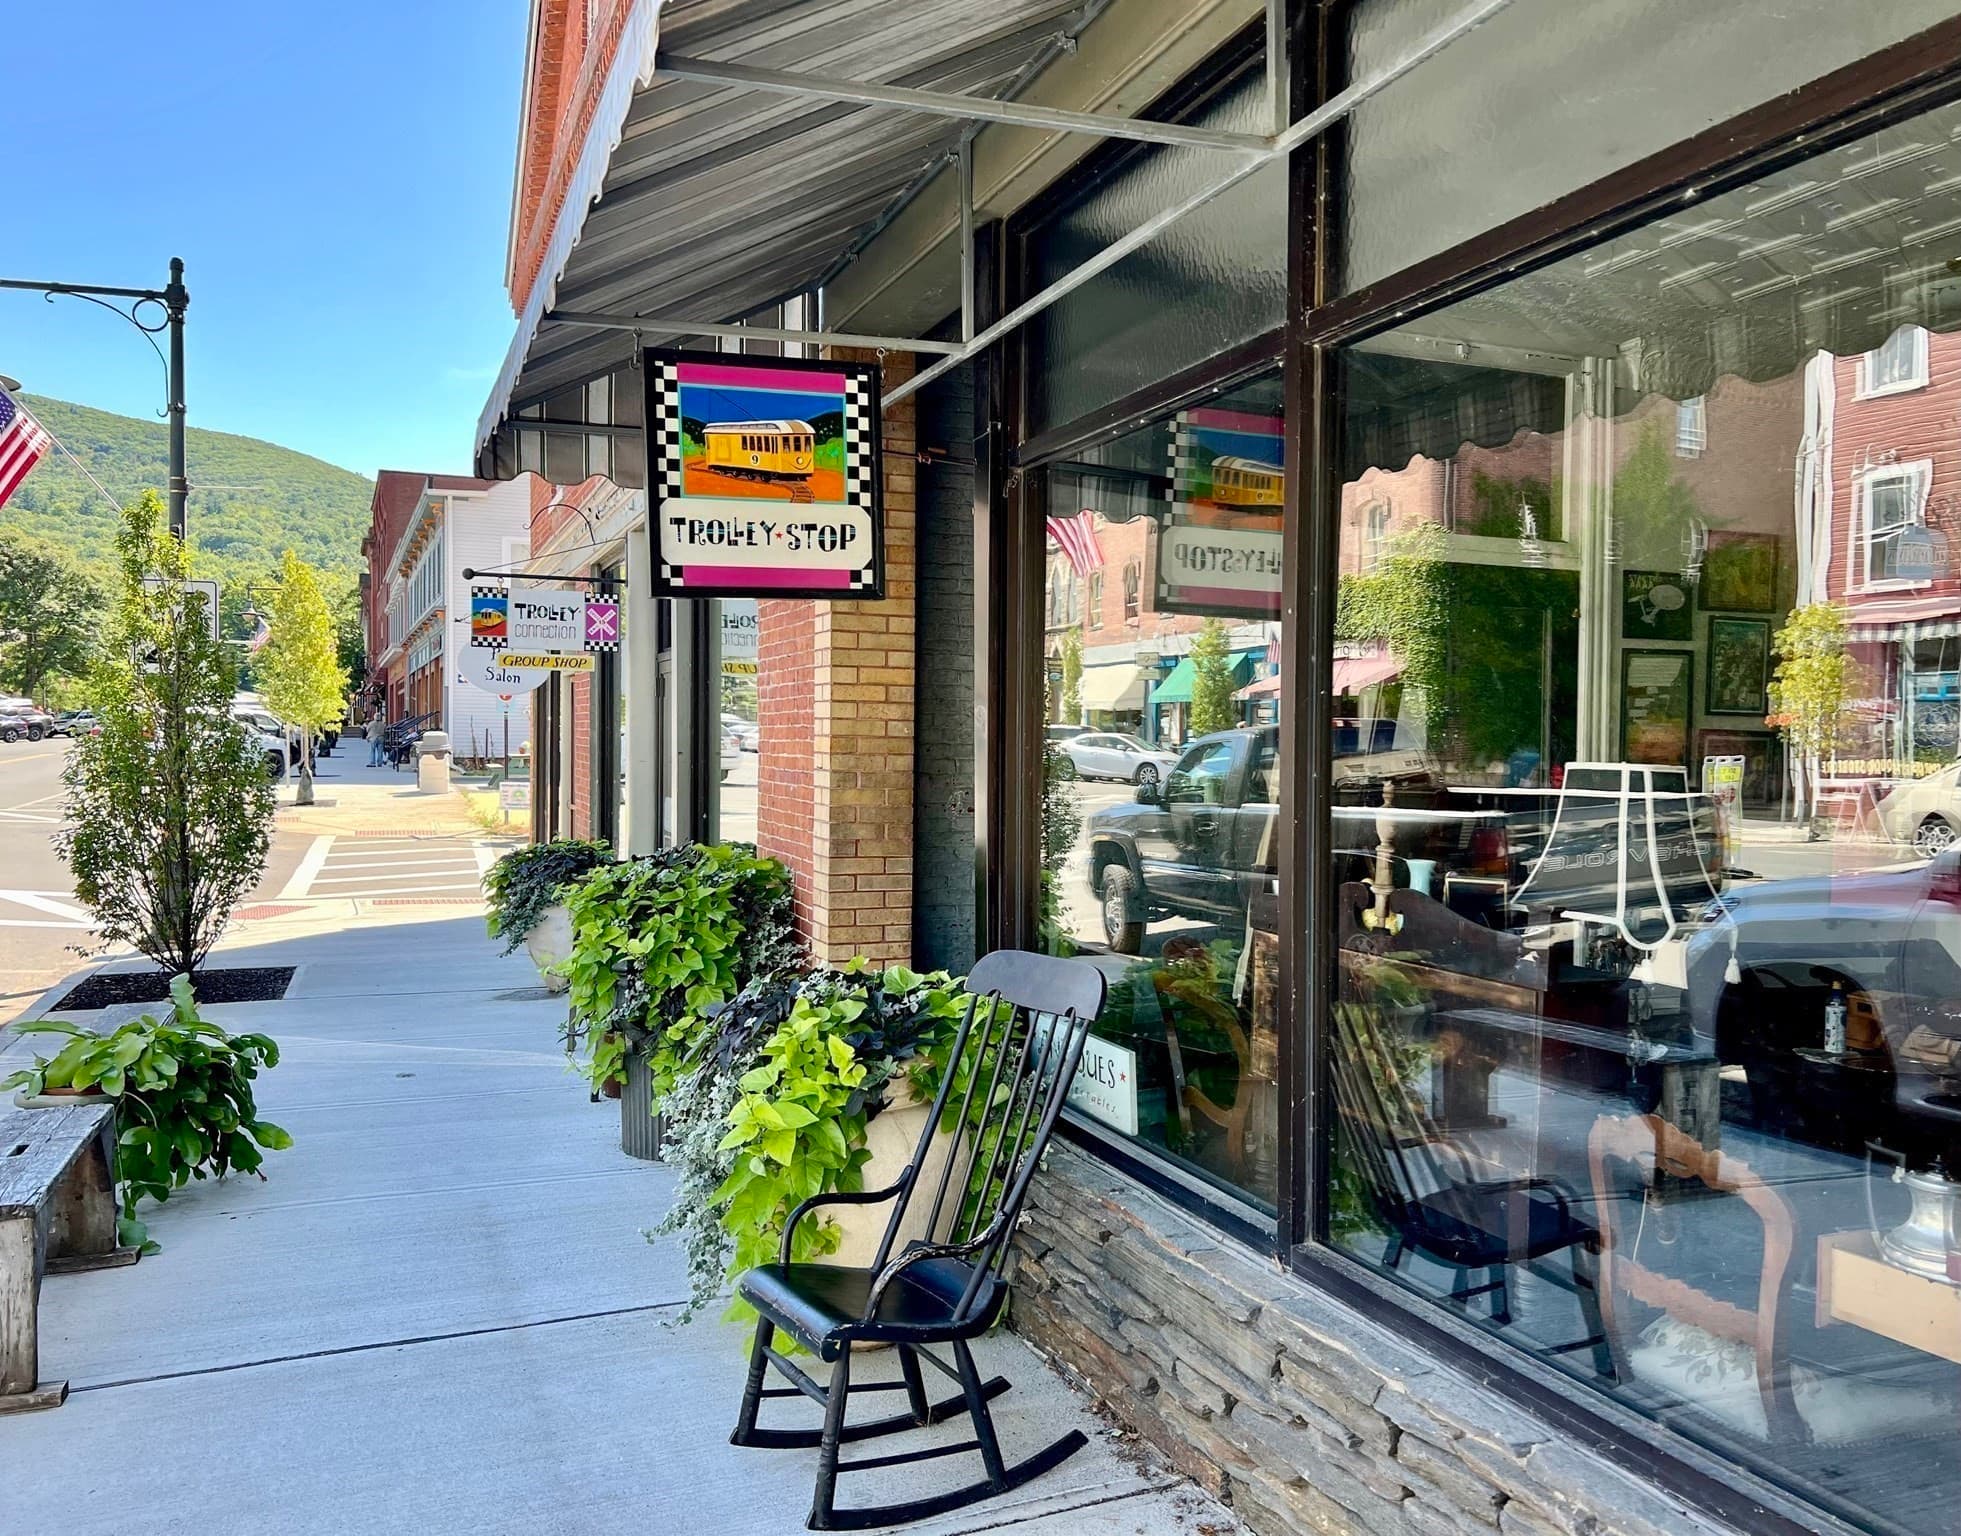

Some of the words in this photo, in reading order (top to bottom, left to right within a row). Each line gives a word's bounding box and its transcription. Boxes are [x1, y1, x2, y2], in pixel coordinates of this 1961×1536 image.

[751, 454, 759, 465] 9
[670, 516, 776, 547] TROLLEY
[786, 522, 856, 552] STOP
[514, 602, 580, 622] TROLLEY
[514, 623, 576, 640] connection
[502, 655, 550, 668] GROUP
[552, 656, 588, 669] SHOP
[485, 666, 520, 684] Salon
